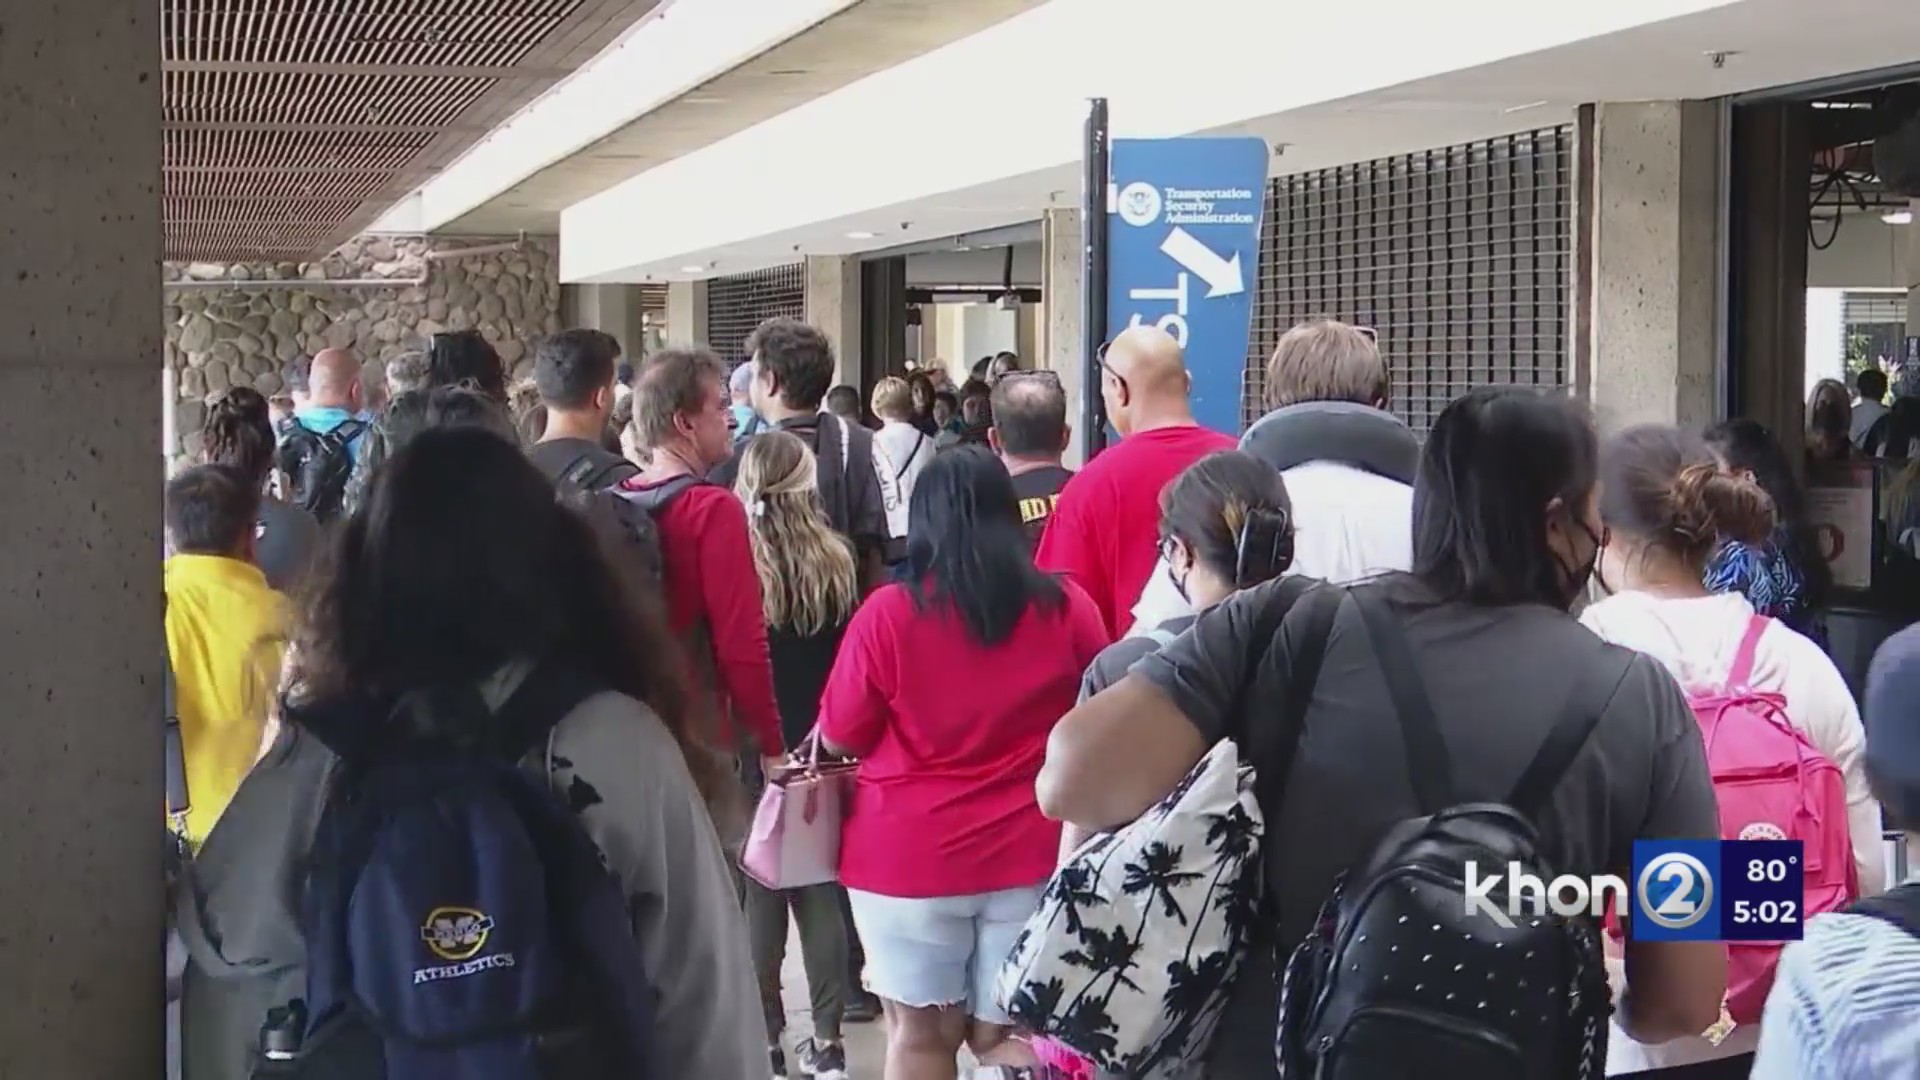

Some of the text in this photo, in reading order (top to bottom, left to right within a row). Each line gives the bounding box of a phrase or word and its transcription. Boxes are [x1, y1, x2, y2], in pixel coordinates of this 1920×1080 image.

[1164, 187, 1252, 201] Transportation
[1164, 199, 1215, 212] Security
[1164, 212, 1254, 224] Administration
[413, 953, 515, 984] ATHLETICS
